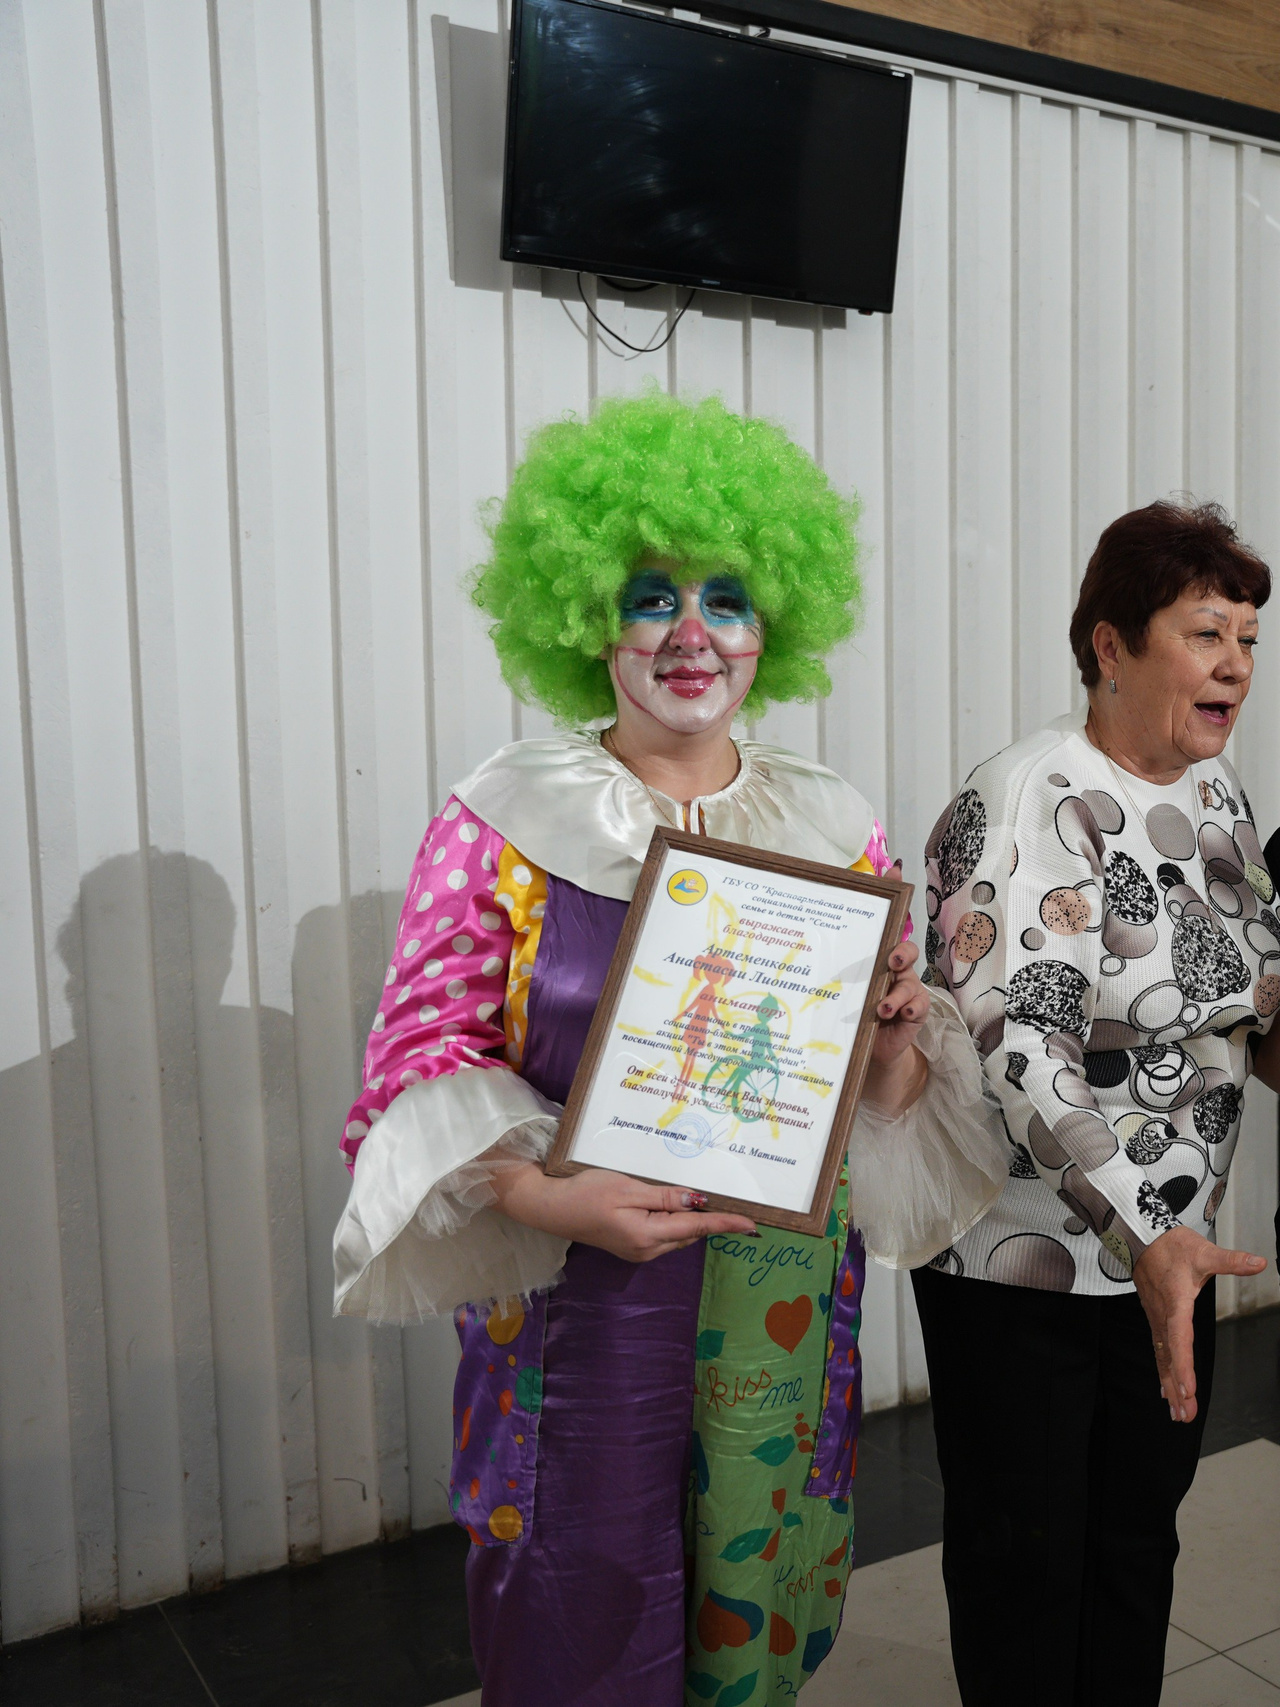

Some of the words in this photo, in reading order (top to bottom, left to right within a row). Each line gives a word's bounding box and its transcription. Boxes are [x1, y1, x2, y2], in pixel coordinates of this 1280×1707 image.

[722, 876, 742, 886] ГБУ
[744, 882, 759, 890] СО
[762, 885, 844, 910] "Красноармейский
[846, 907, 874, 918] центр
[751, 896, 803, 911] социальной
[804, 908, 841, 920] помощи
[738, 918, 804, 938] выражает
[741, 904, 766, 913] семье
[775, 910, 805, 922] детям
[809, 917, 847, 930] "Семья"
[722, 924, 812, 952] благодарность
[663, 952, 747, 979] Анастасии
[748, 971, 840, 1000] Лионтьевне
[702, 943, 811, 976] Артеменковой
[700, 994, 786, 1019] аниматору
[663, 1019, 803, 1055] социально-благотворительной
[694, 1014, 730, 1028] помощь
[739, 1024, 790, 1040] проведении
[621, 1034, 682, 1053] посвященной
[683, 1047, 765, 1073] Международному
[766, 1066, 785, 1077] дню
[787, 1072, 834, 1087] инвалидов
[656, 1030, 684, 1041] акции
[714, 1044, 738, 1053] этом
[739, 1049, 763, 1059] мире
[627, 1065, 644, 1076] От
[646, 1072, 668, 1082] всей
[698, 1083, 739, 1099] желаем
[741, 1091, 762, 1104] Вам
[741, 1108, 813, 1130] процветания!
[608, 1116, 653, 1135] Директор
[654, 1128, 687, 1140] центра
[748, 1148, 796, 1165] Матяшова
[748, 1244, 814, 1287] you
[708, 1366, 772, 1413] kiss
[760, 1377, 805, 1410] me
